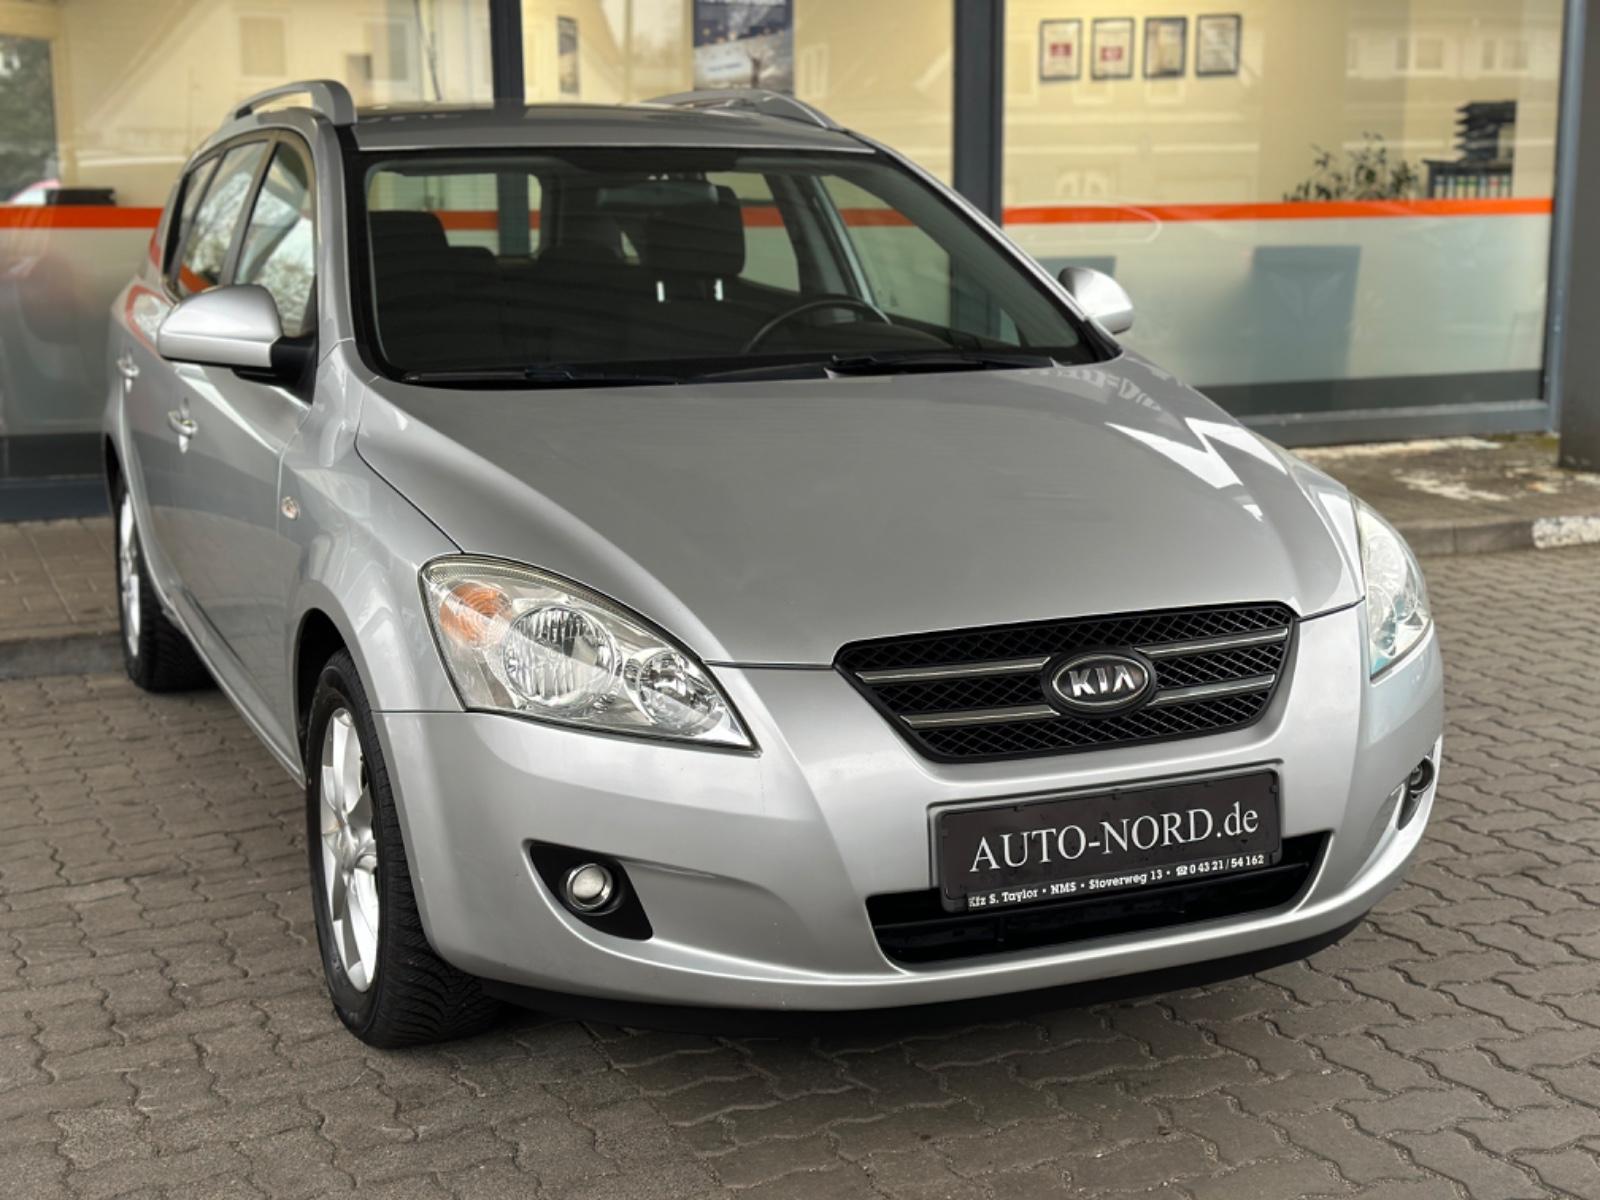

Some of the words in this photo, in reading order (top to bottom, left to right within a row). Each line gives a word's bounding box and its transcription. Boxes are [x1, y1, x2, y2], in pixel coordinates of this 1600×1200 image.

[1069, 665, 1136, 697] KIA
[968, 801, 1259, 873] AUTO-NORD.de
[988, 892, 1000, 904] S.
[1001, 888, 1039, 903] Taylor
[1050, 881, 1077, 895] NMS
[1150, 869, 1163, 880] 13
